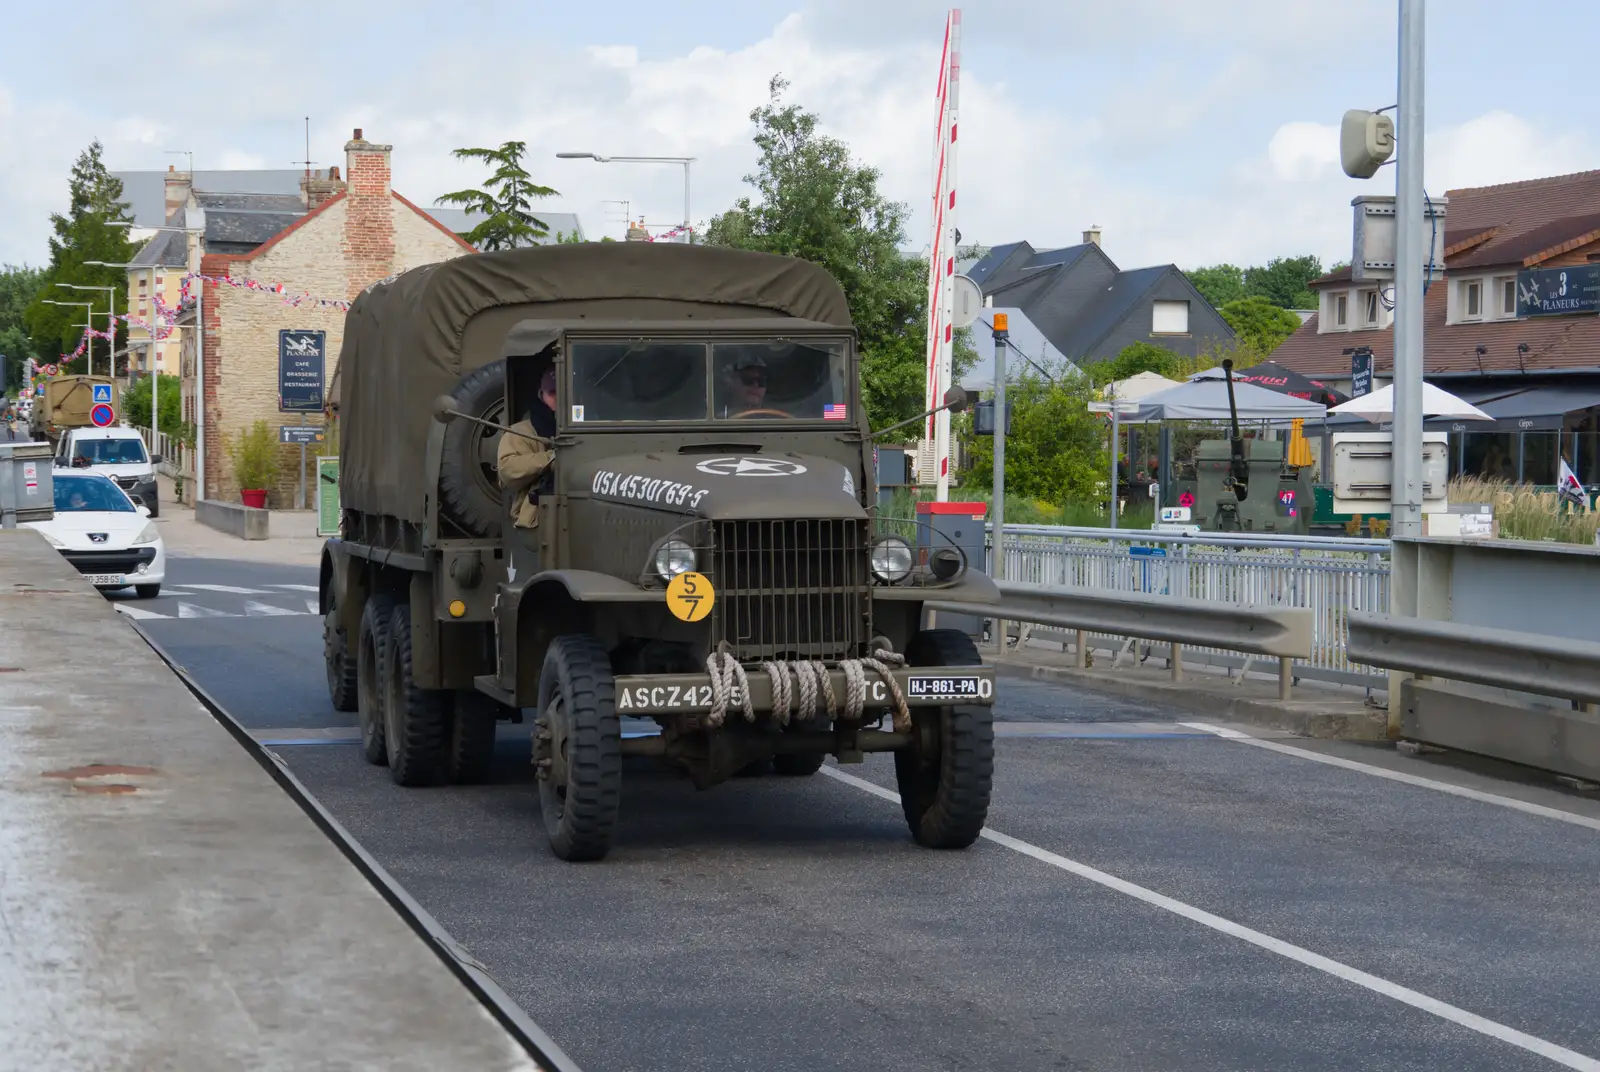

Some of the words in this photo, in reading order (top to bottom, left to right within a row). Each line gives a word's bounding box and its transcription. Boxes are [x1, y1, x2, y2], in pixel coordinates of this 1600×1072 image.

[1559, 271, 1567, 296] 3
[1543, 299, 1580, 310] PLANEURS
[1281, 493, 1293, 504] 47
[684, 574, 697, 595] 5
[685, 599, 699, 620] 7
[911, 680, 976, 693] HJ-861-PA
